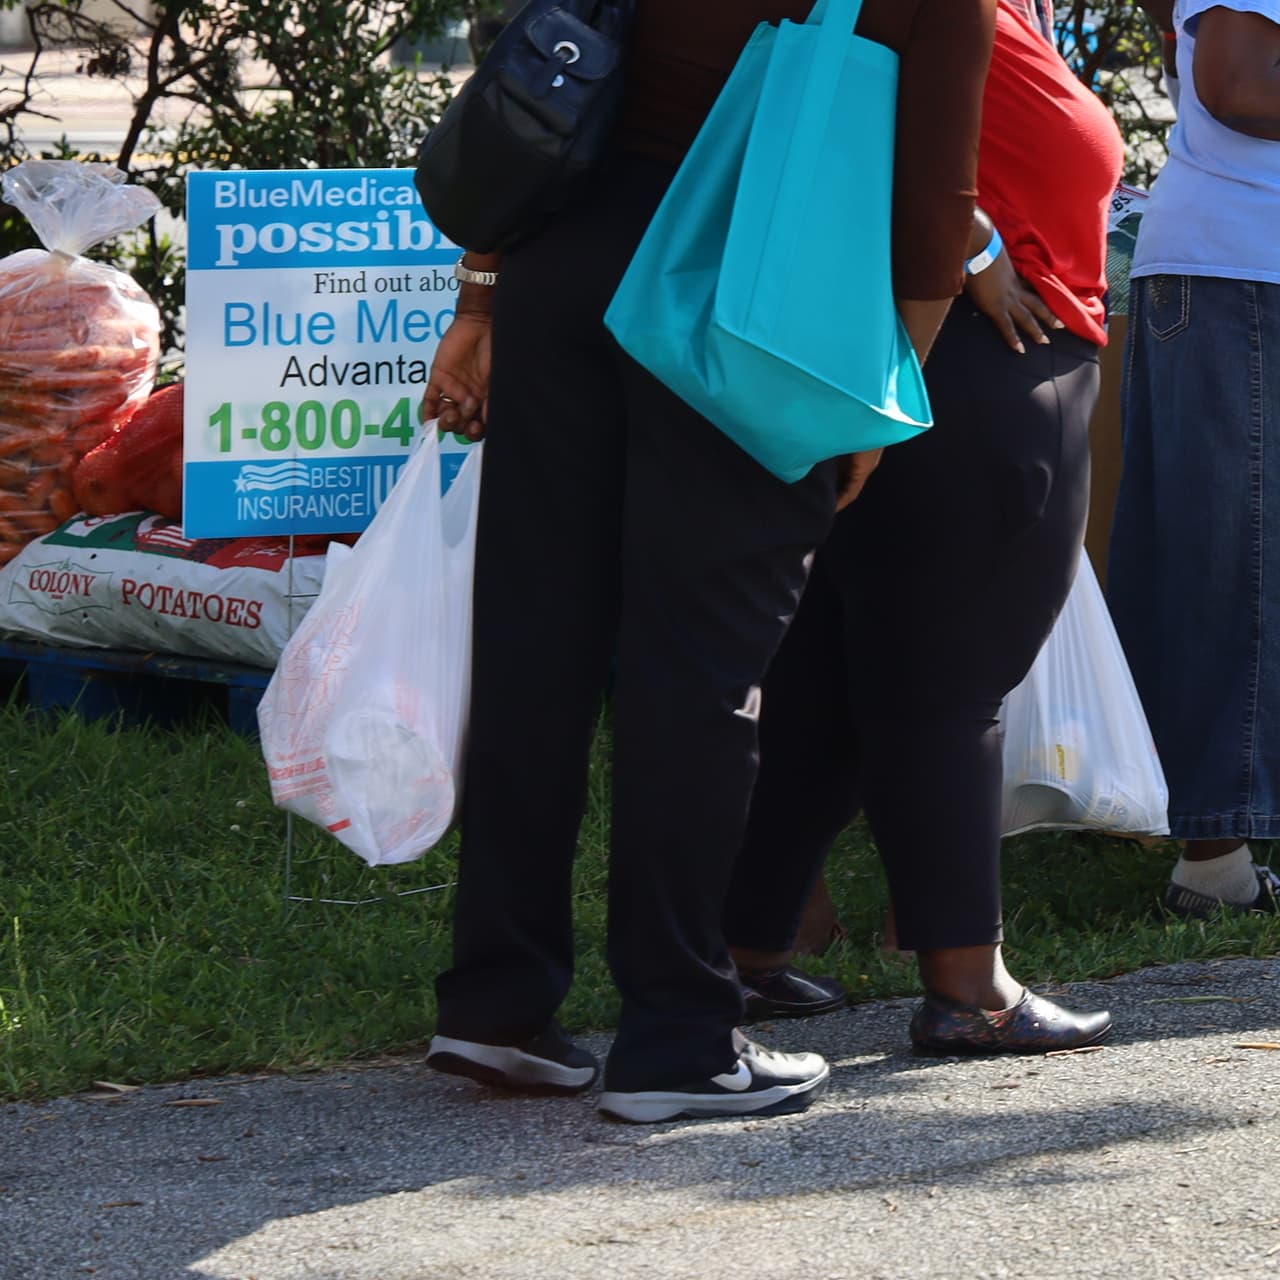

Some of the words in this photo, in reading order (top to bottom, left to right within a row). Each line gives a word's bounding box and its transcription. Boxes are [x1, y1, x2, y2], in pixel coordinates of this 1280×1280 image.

[313, 271, 367, 294] Find
[374, 274, 412, 293] out
[419, 270, 461, 292] abo
[224, 301, 336, 347] Blue
[280, 354, 427, 387] Advanta
[208, 397, 472, 453] 1-800-4
[310, 465, 363, 488] BEST
[236, 493, 365, 520] INSURANCE
[29, 569, 96, 596] COLONY
[120, 579, 264, 629] POTATOES
